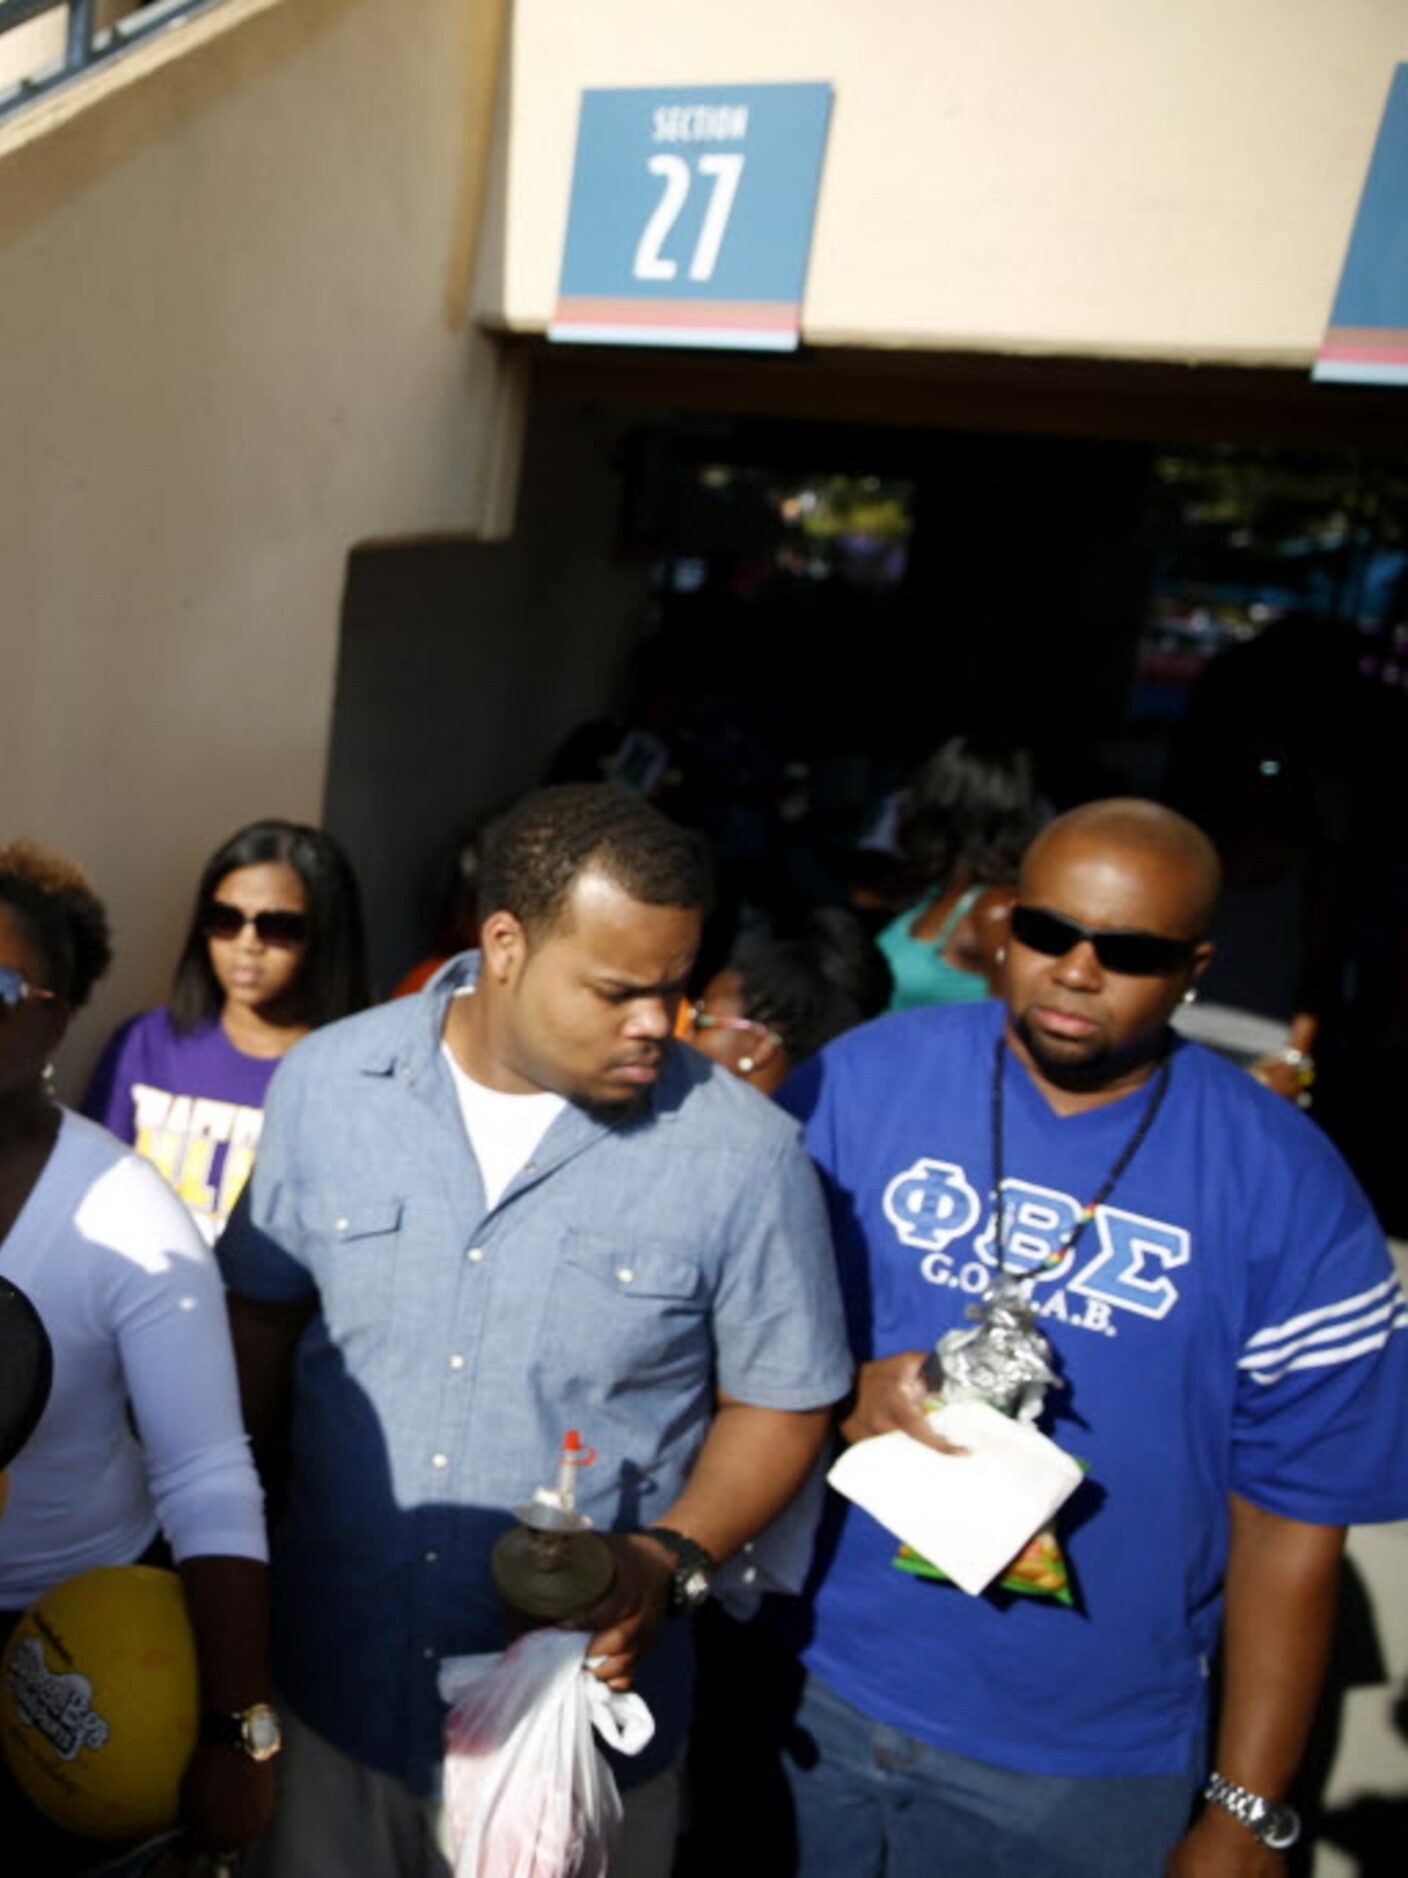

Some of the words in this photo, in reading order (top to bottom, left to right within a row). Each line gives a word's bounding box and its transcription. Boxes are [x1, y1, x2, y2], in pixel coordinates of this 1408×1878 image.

[653, 105, 749, 142] SECTION
[633, 153, 745, 282] 27
[920, 1252, 1117, 1337] G.O..A.B.
